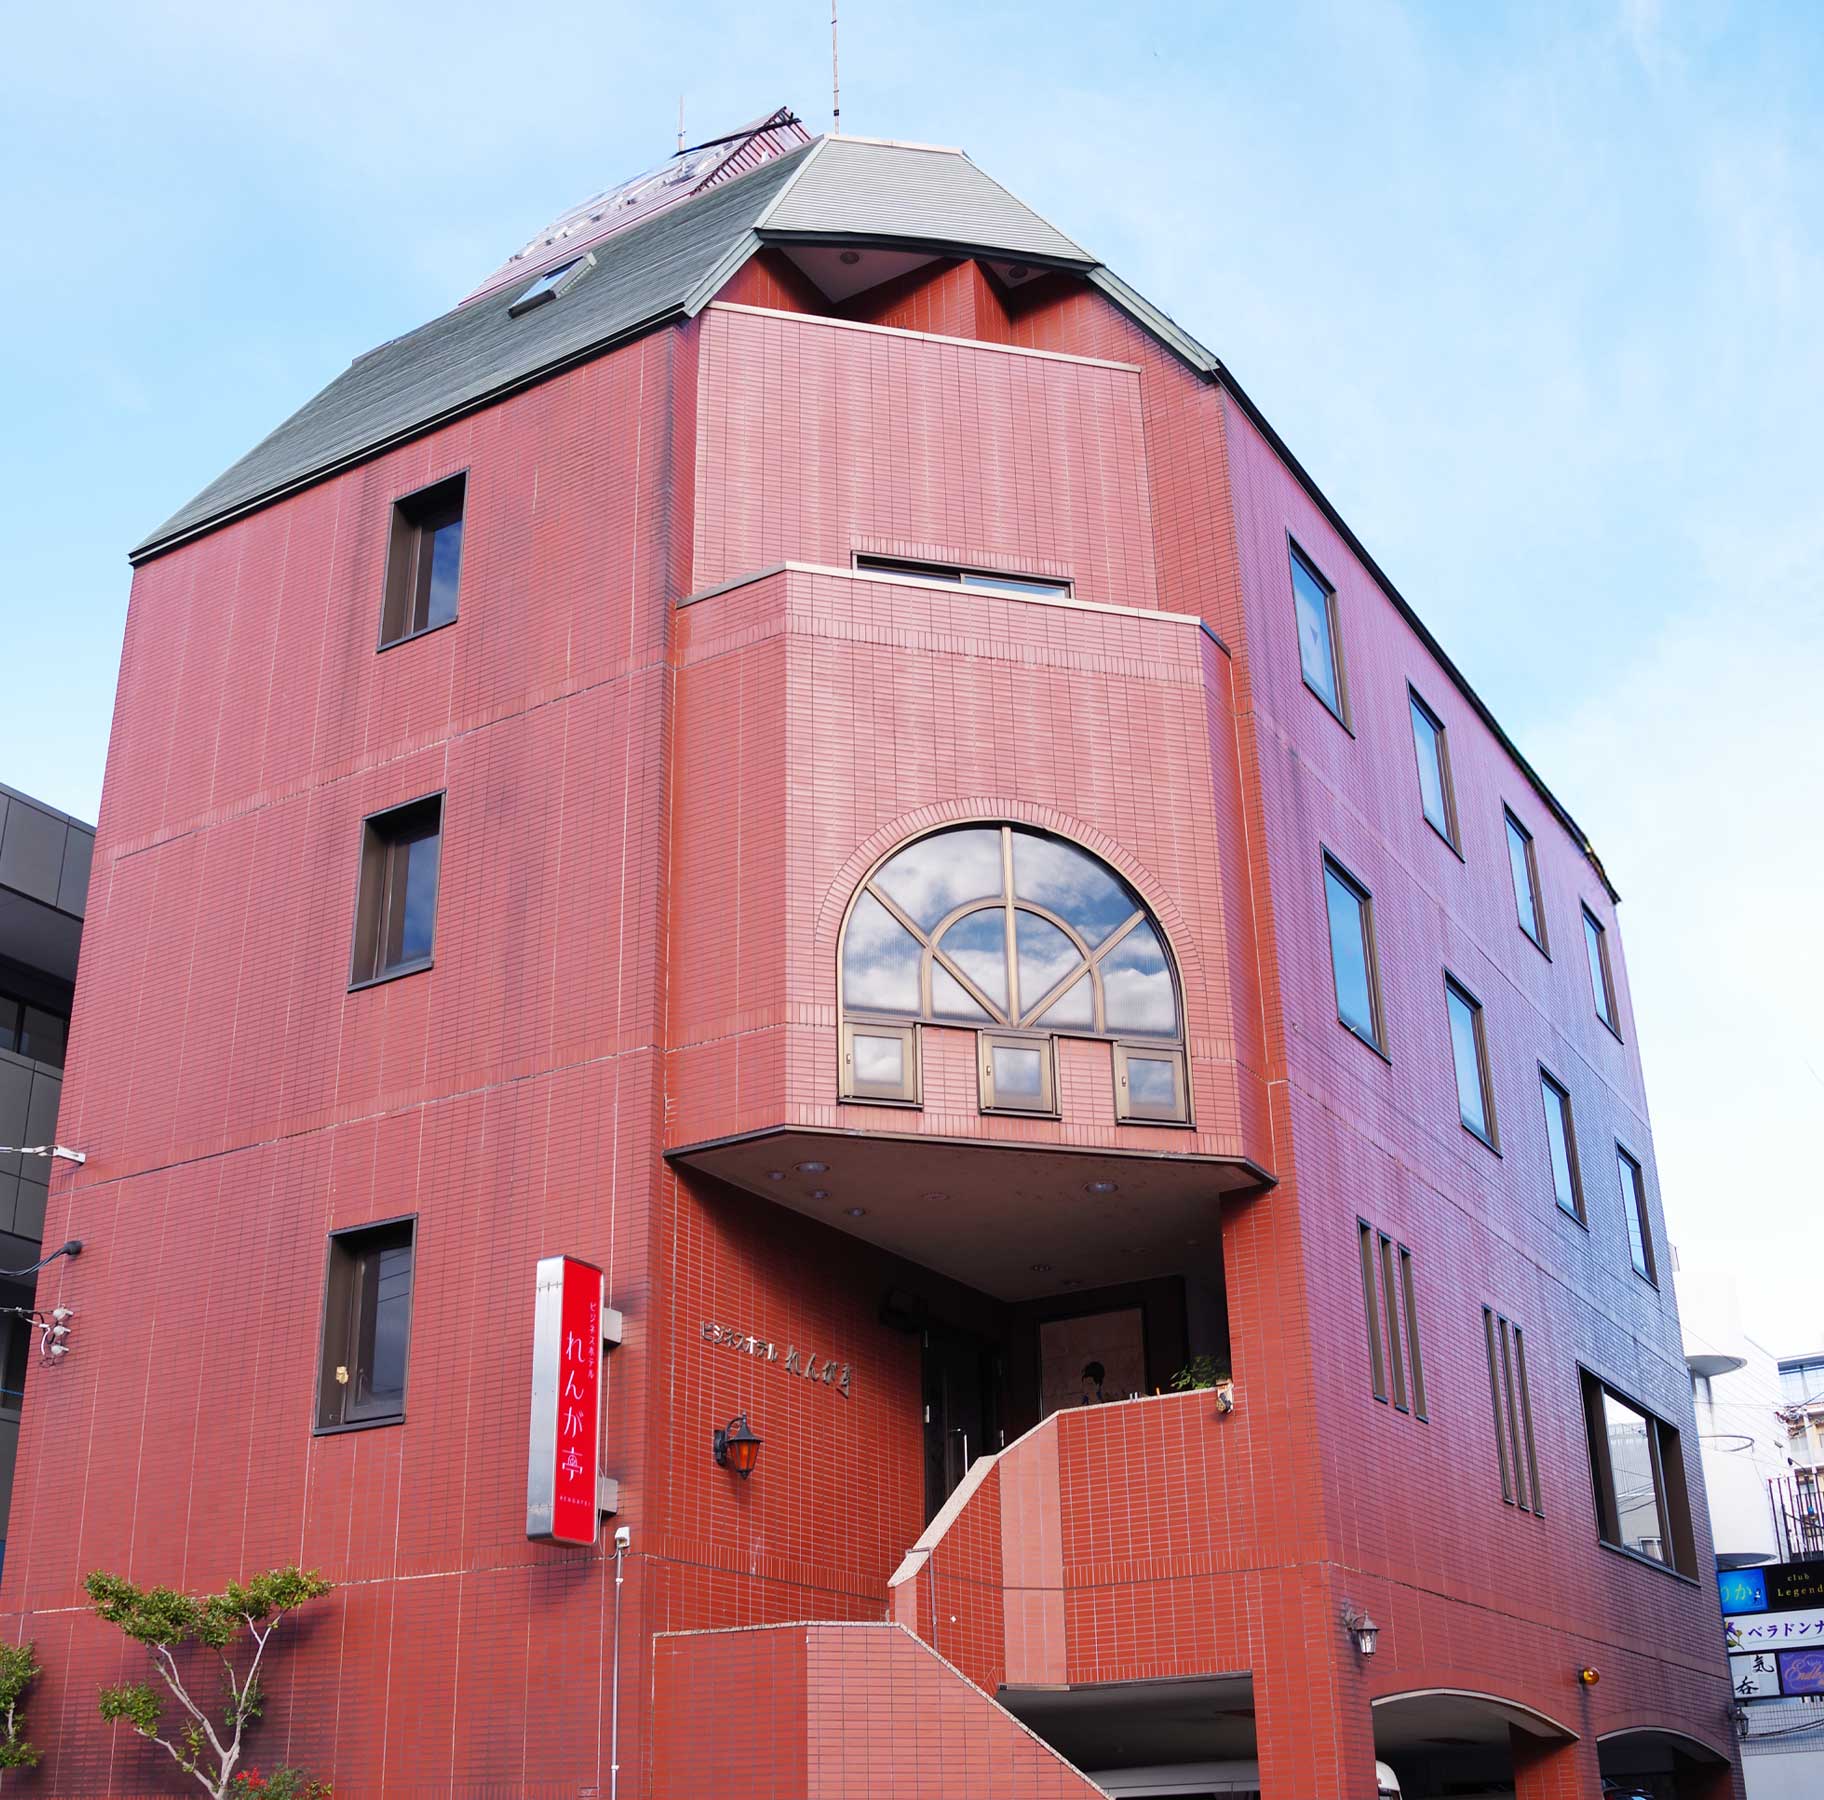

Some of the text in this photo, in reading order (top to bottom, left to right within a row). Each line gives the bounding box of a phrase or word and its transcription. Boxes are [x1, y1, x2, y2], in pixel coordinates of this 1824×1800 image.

[700, 1320, 778, 1362] ビジネスホテル
[562, 1330, 585, 1482] れんが亭
[1787, 1573, 1810, 1582] club
